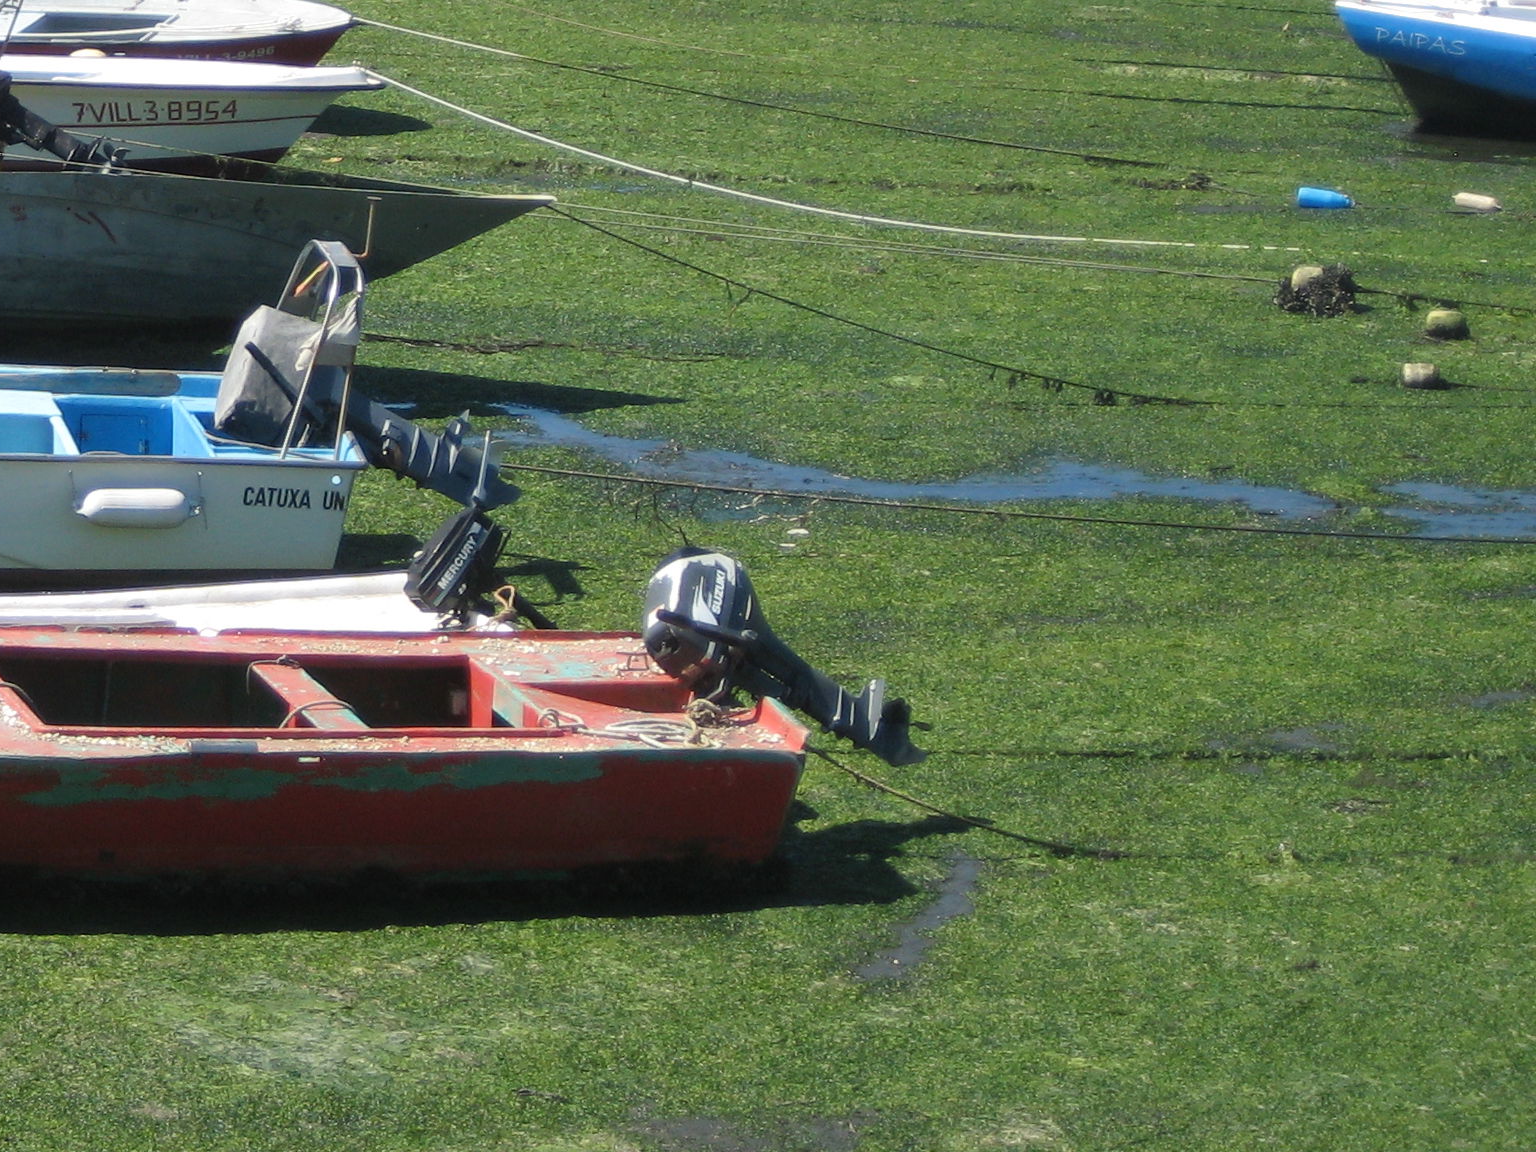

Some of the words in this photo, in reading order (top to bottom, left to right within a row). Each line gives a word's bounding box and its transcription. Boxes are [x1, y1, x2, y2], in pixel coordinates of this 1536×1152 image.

[1375, 26, 1466, 56] PAIPAS
[243, 486, 311, 509] CATUXA
[437, 535, 478, 590] MERCURY
[710, 568, 726, 616] SUZUKI
